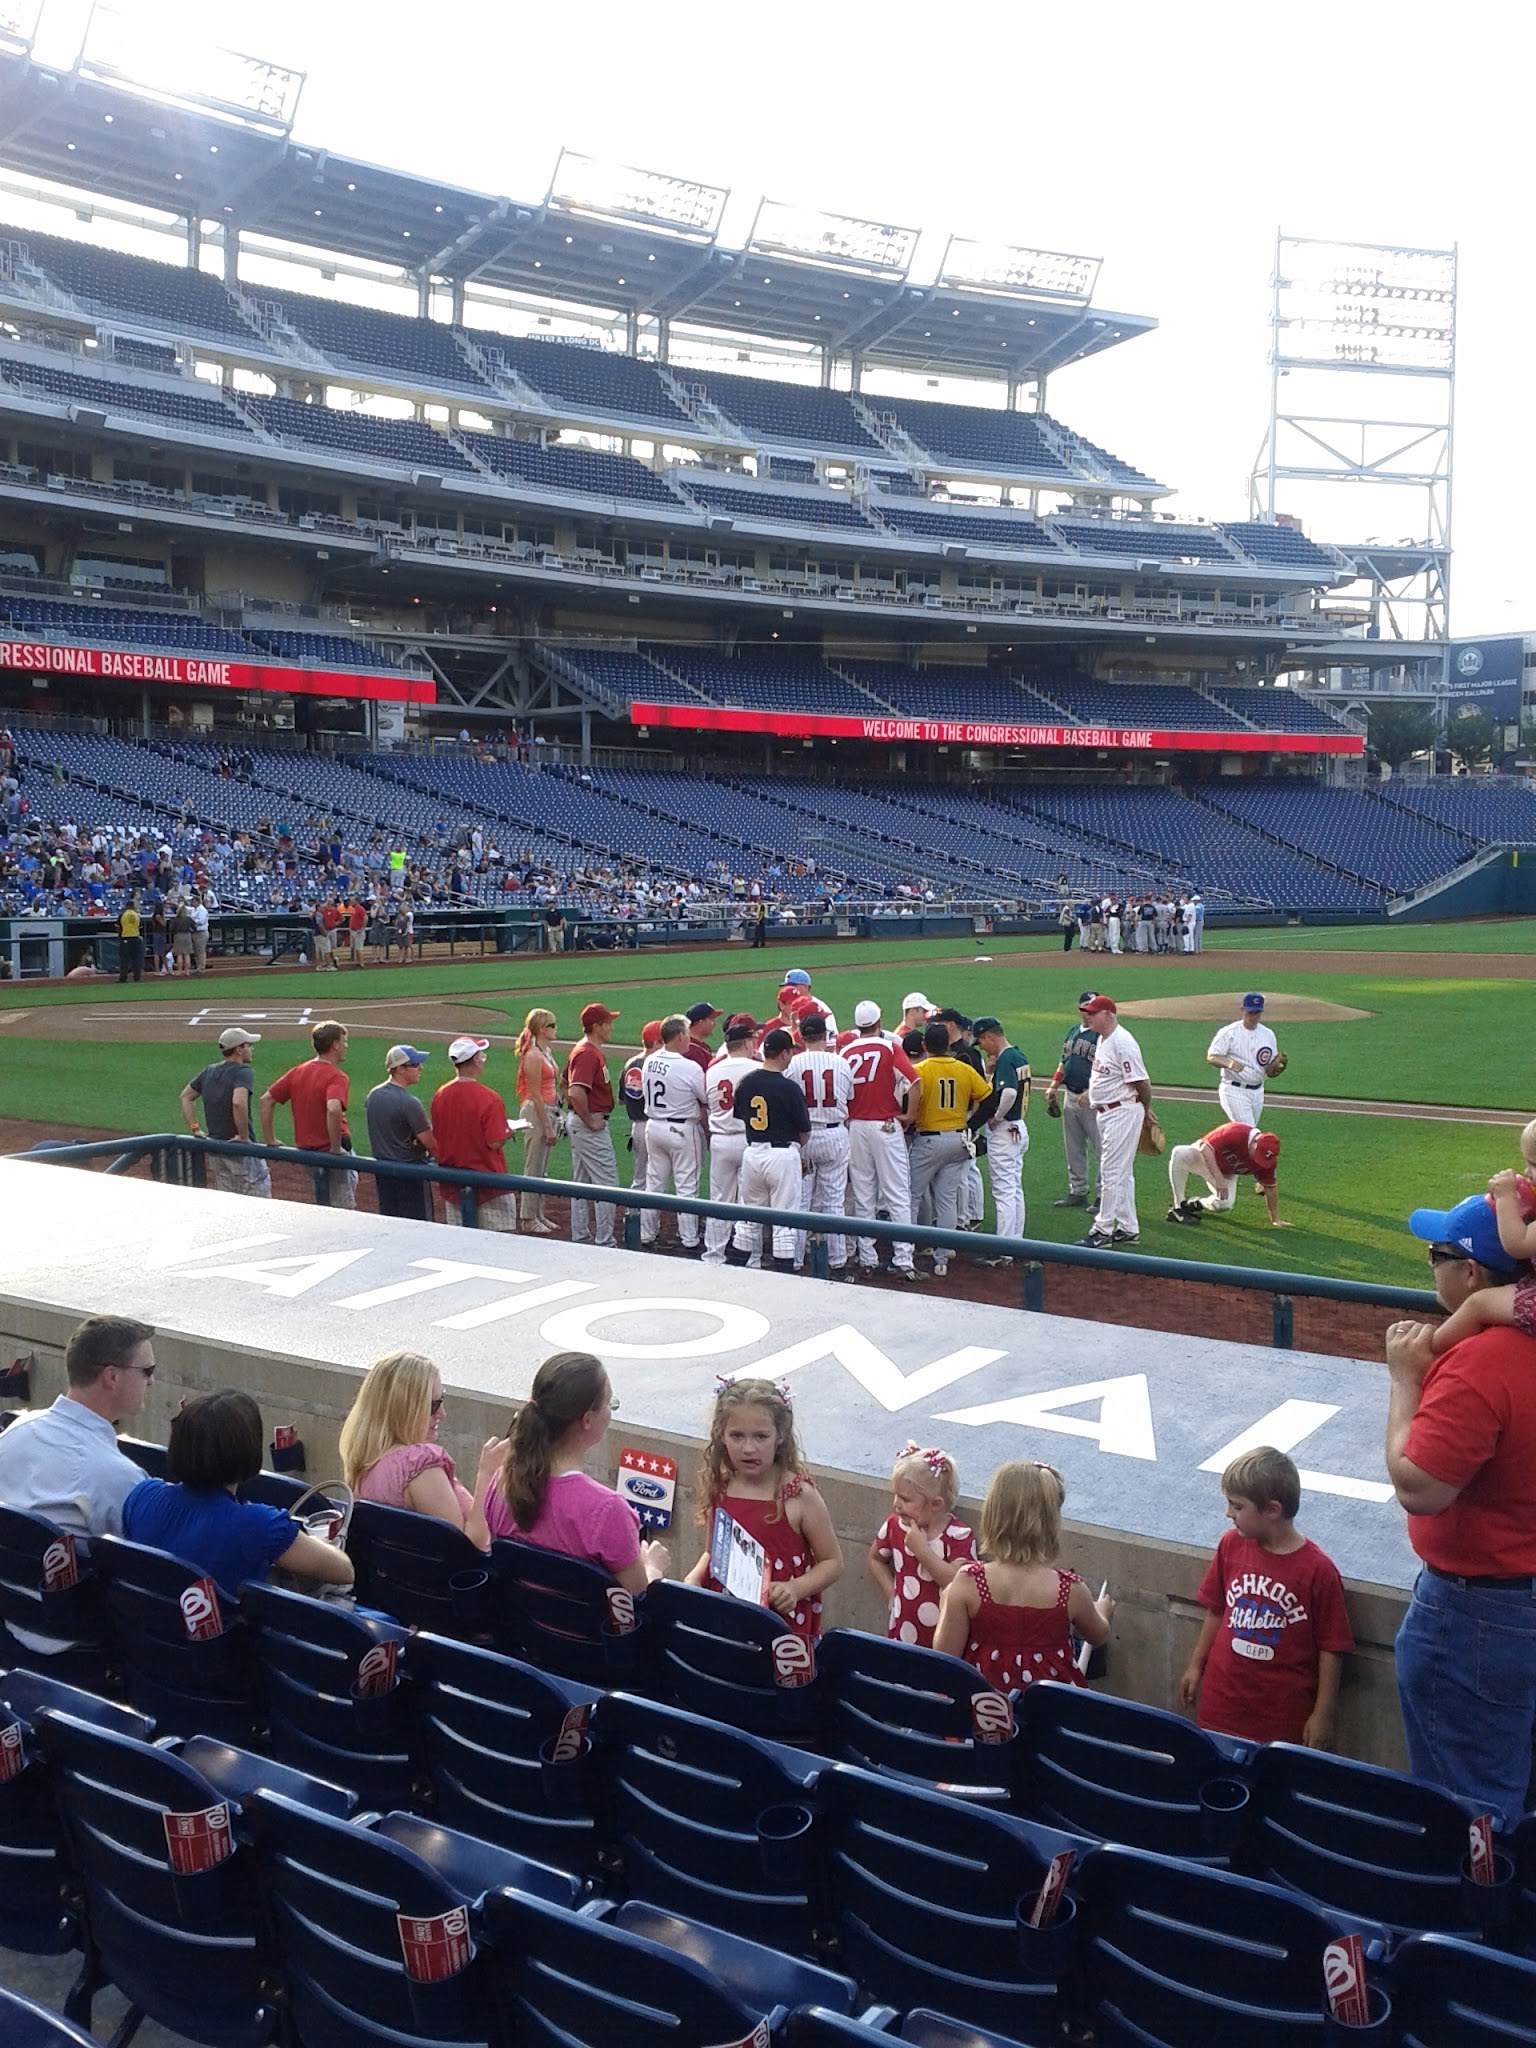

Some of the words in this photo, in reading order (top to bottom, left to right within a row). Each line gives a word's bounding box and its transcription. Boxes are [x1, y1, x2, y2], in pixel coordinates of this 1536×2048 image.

[564, 337, 587, 345] LONG
[101, 652, 182, 681] BASEBALL
[186, 661, 231, 685] GAME
[863, 720, 920, 739] WELCOME
[924, 723, 938, 739] TO
[942, 724, 962, 741] THE
[966, 725, 1059, 745] CONGRESSIONAL
[1063, 729, 1118, 747] BASEBALL
[1122, 731, 1152, 748] GAME
[648, 1060, 670, 1077] ROSS
[846, 1050, 881, 1085] 27
[646, 1079, 667, 1109] 12
[717, 1079, 734, 1111] 3
[801, 1069, 837, 1108] 11
[938, 1077, 957, 1110] 11
[750, 1095, 769, 1132] 3
[632, 1478, 659, 1499] Ford
[1226, 1573, 1308, 1625] OSHKOSH
[1227, 1606, 1288, 1630] Athletics
[1245, 1644, 1270, 1658] DEPT
